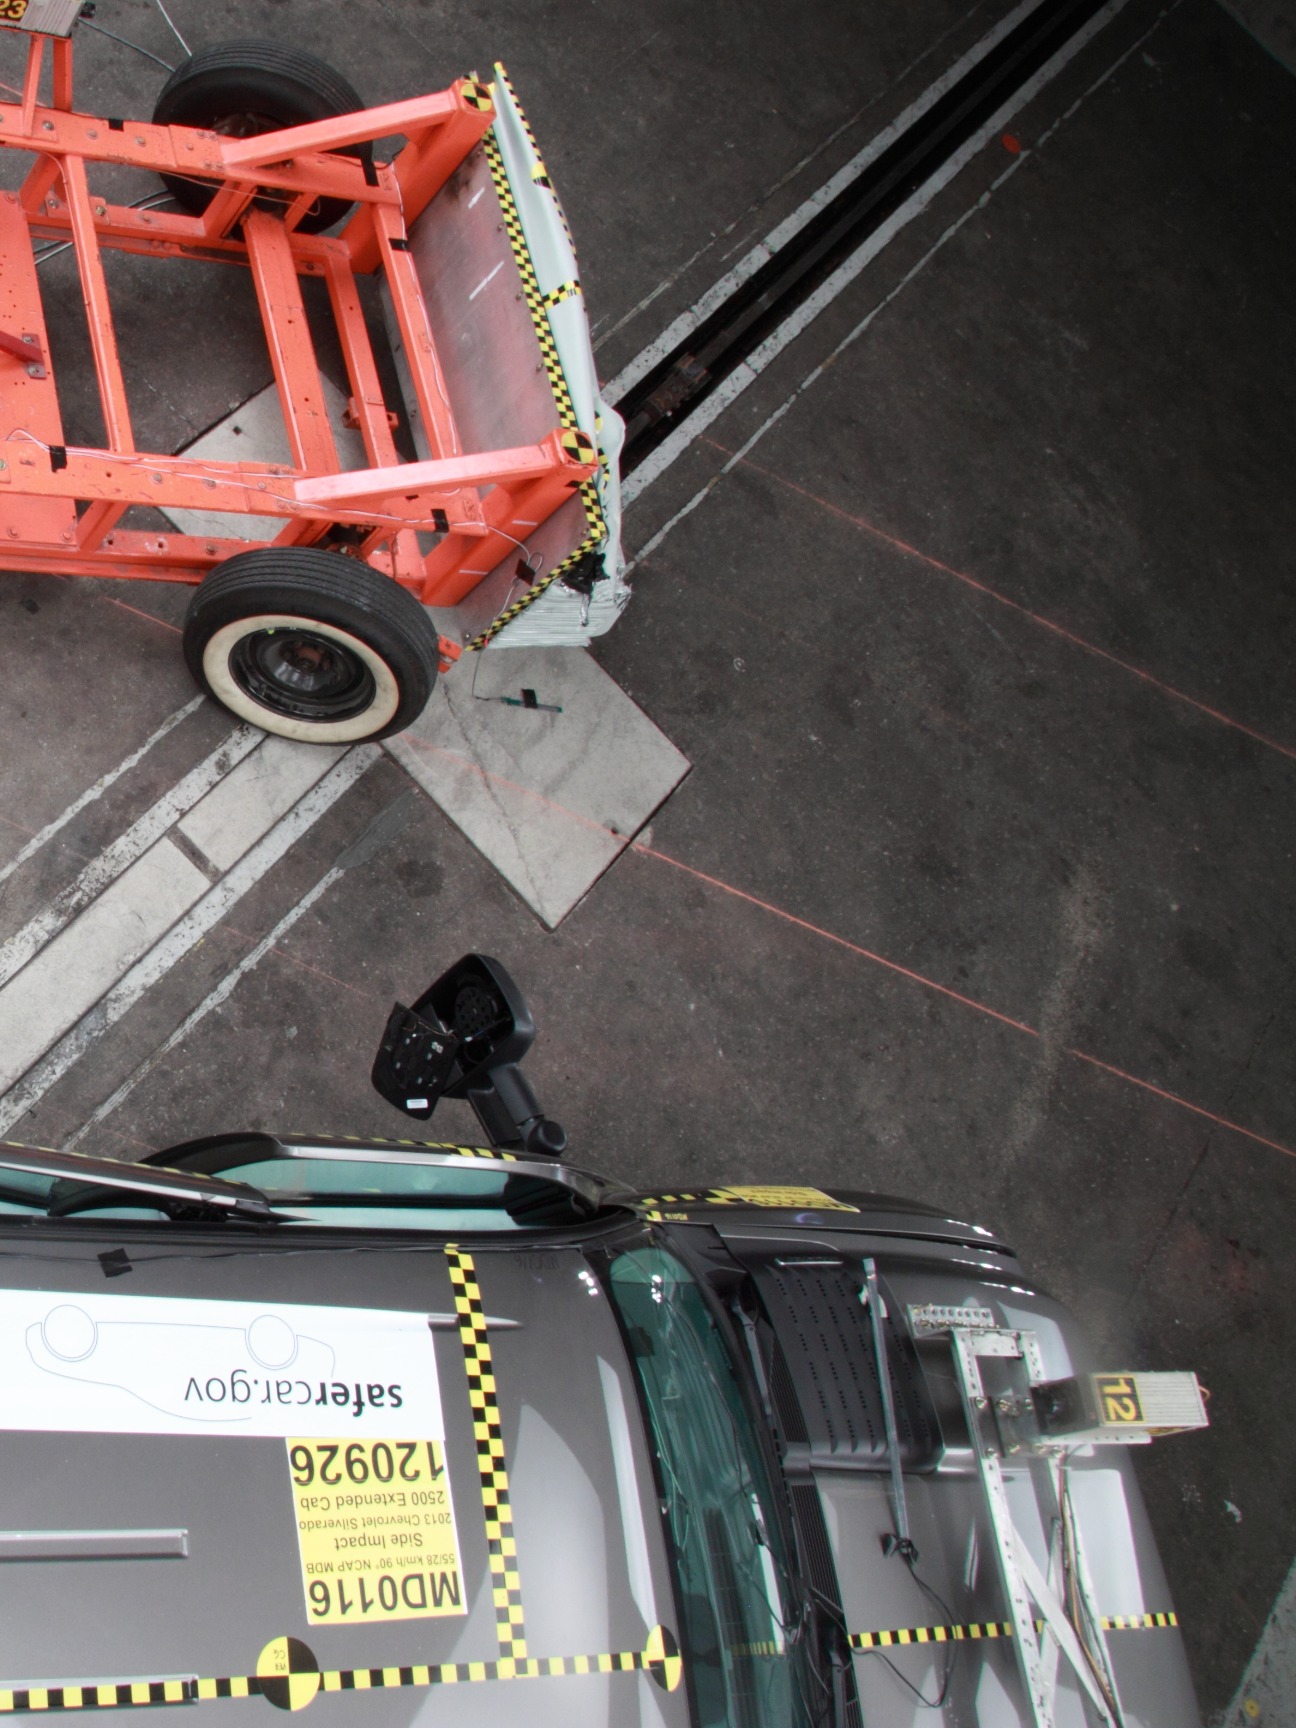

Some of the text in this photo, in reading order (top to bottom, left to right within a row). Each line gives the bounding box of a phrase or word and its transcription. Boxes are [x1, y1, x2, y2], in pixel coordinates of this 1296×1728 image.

[184, 1369, 403, 1417] safercar.gov
[1103, 1379, 1136, 1421] 12
[290, 1441, 444, 1486] 120926
[300, 1490, 445, 1511] 2500 Extended Cab
[299, 1513, 452, 1531] 2013 Chevrolet Silverado
[334, 1532, 423, 1550] Side Impact
[306, 1562, 334, 1574] MDB
[338, 1559, 371, 1572] NCAP
[396, 1555, 423, 1567] km/h
[426, 1553, 455, 1565] 55/28
[309, 1570, 461, 1617] MD0116
